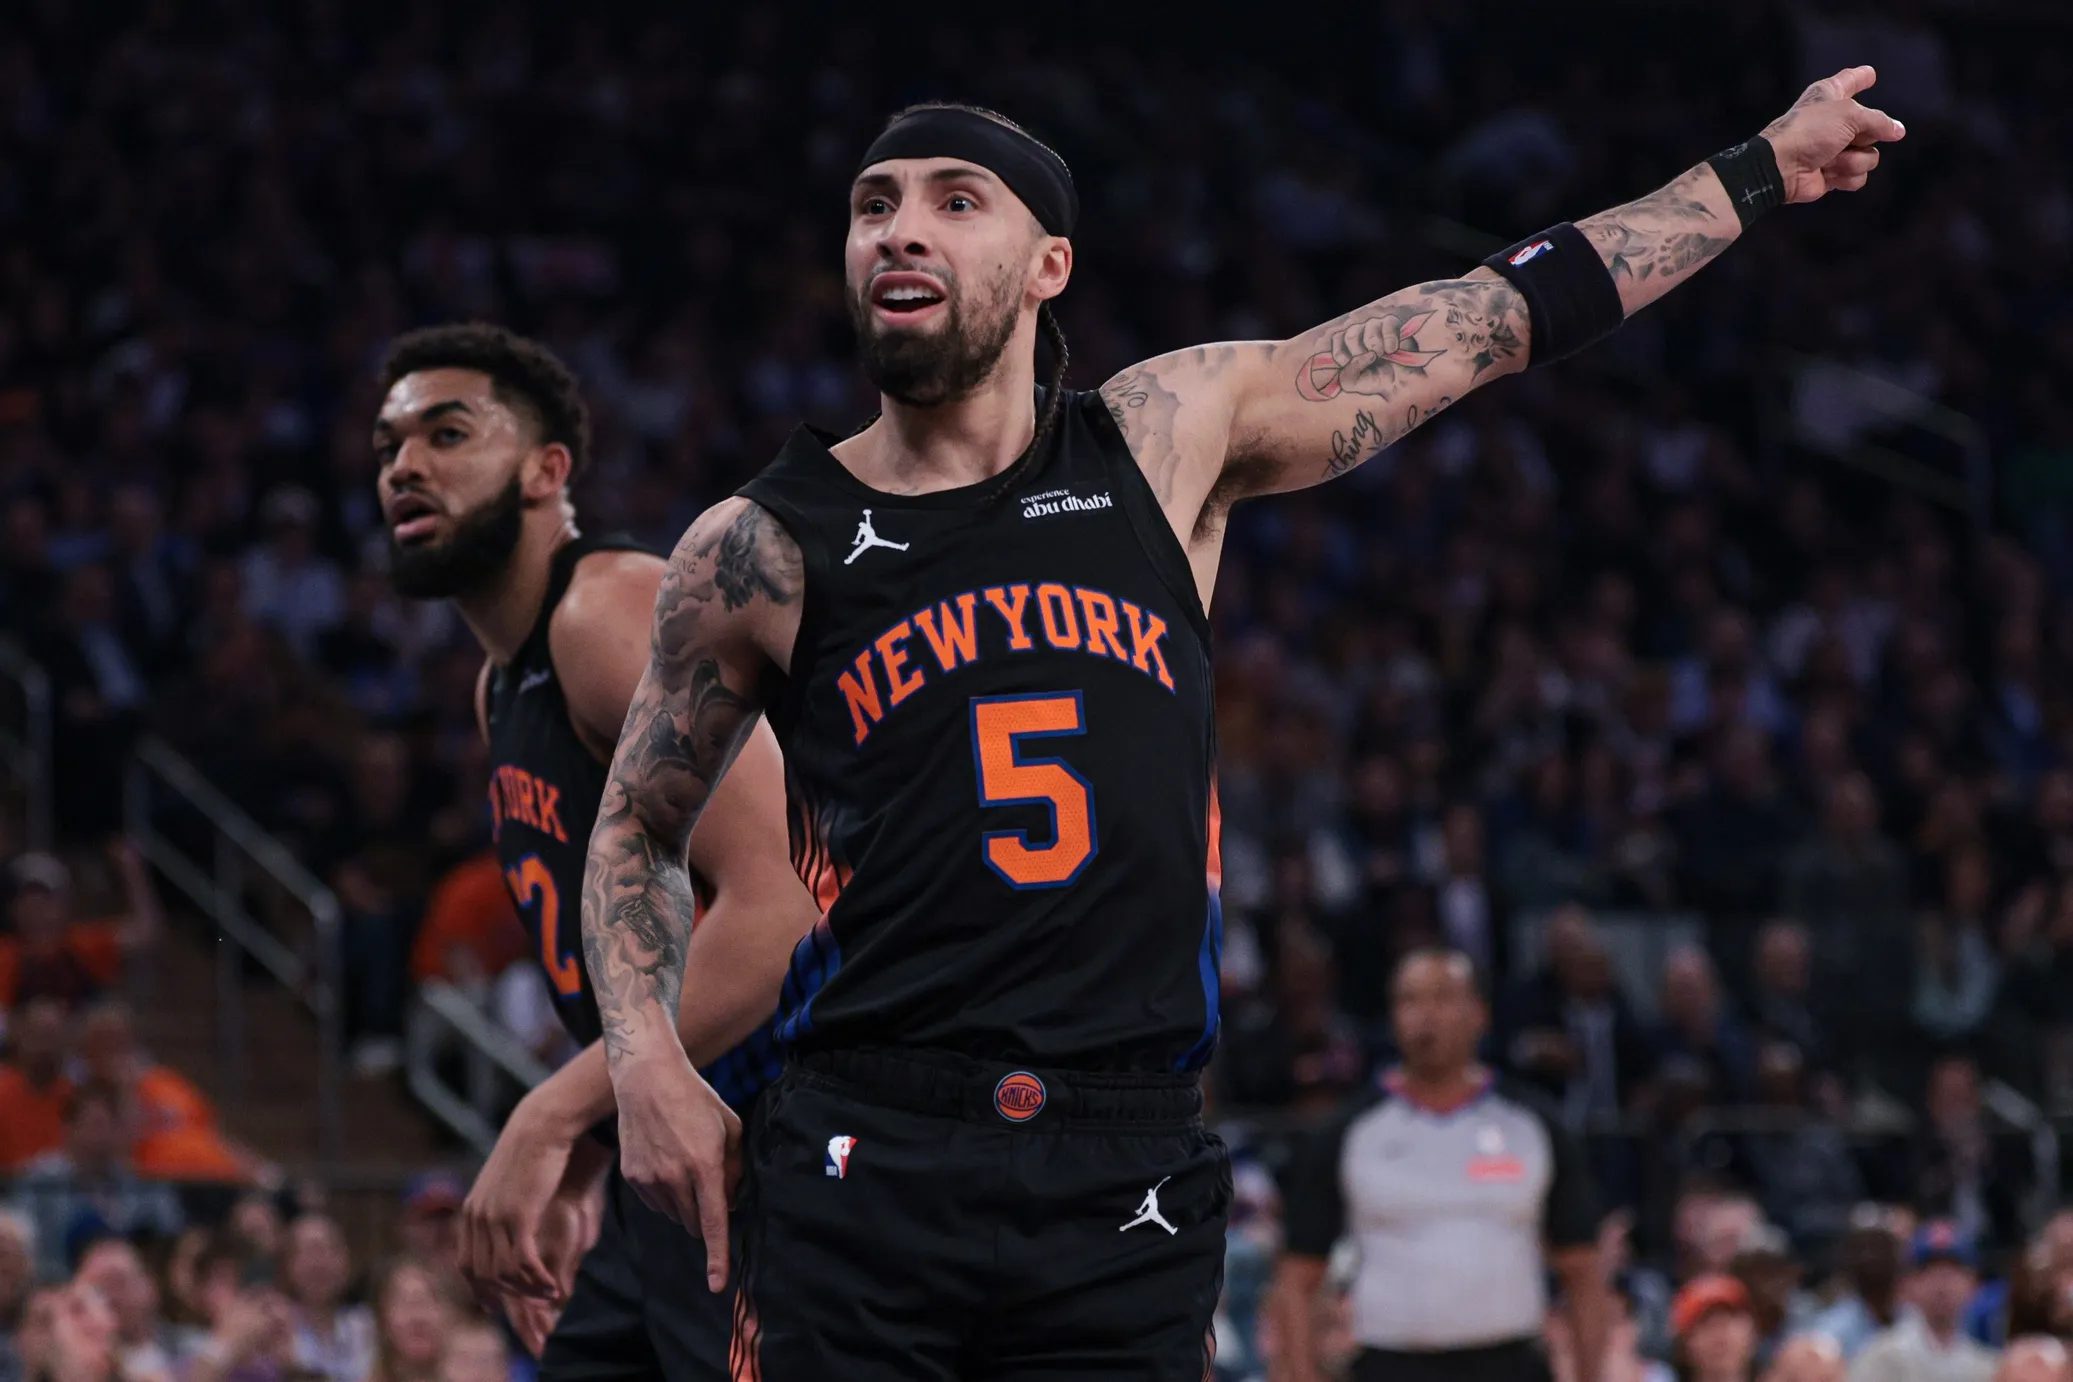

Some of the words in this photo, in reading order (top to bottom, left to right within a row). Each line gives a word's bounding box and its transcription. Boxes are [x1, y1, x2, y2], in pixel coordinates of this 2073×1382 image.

[1020, 488, 1070, 504] experience
[1022, 500, 1060, 519] abu
[1061, 491, 1113, 512] dhabi
[835, 590, 979, 748] NEW
[982, 581, 1176, 694] YORK
[969, 689, 1099, 890] 5
[1000, 1086, 1040, 1108] KNICKS
